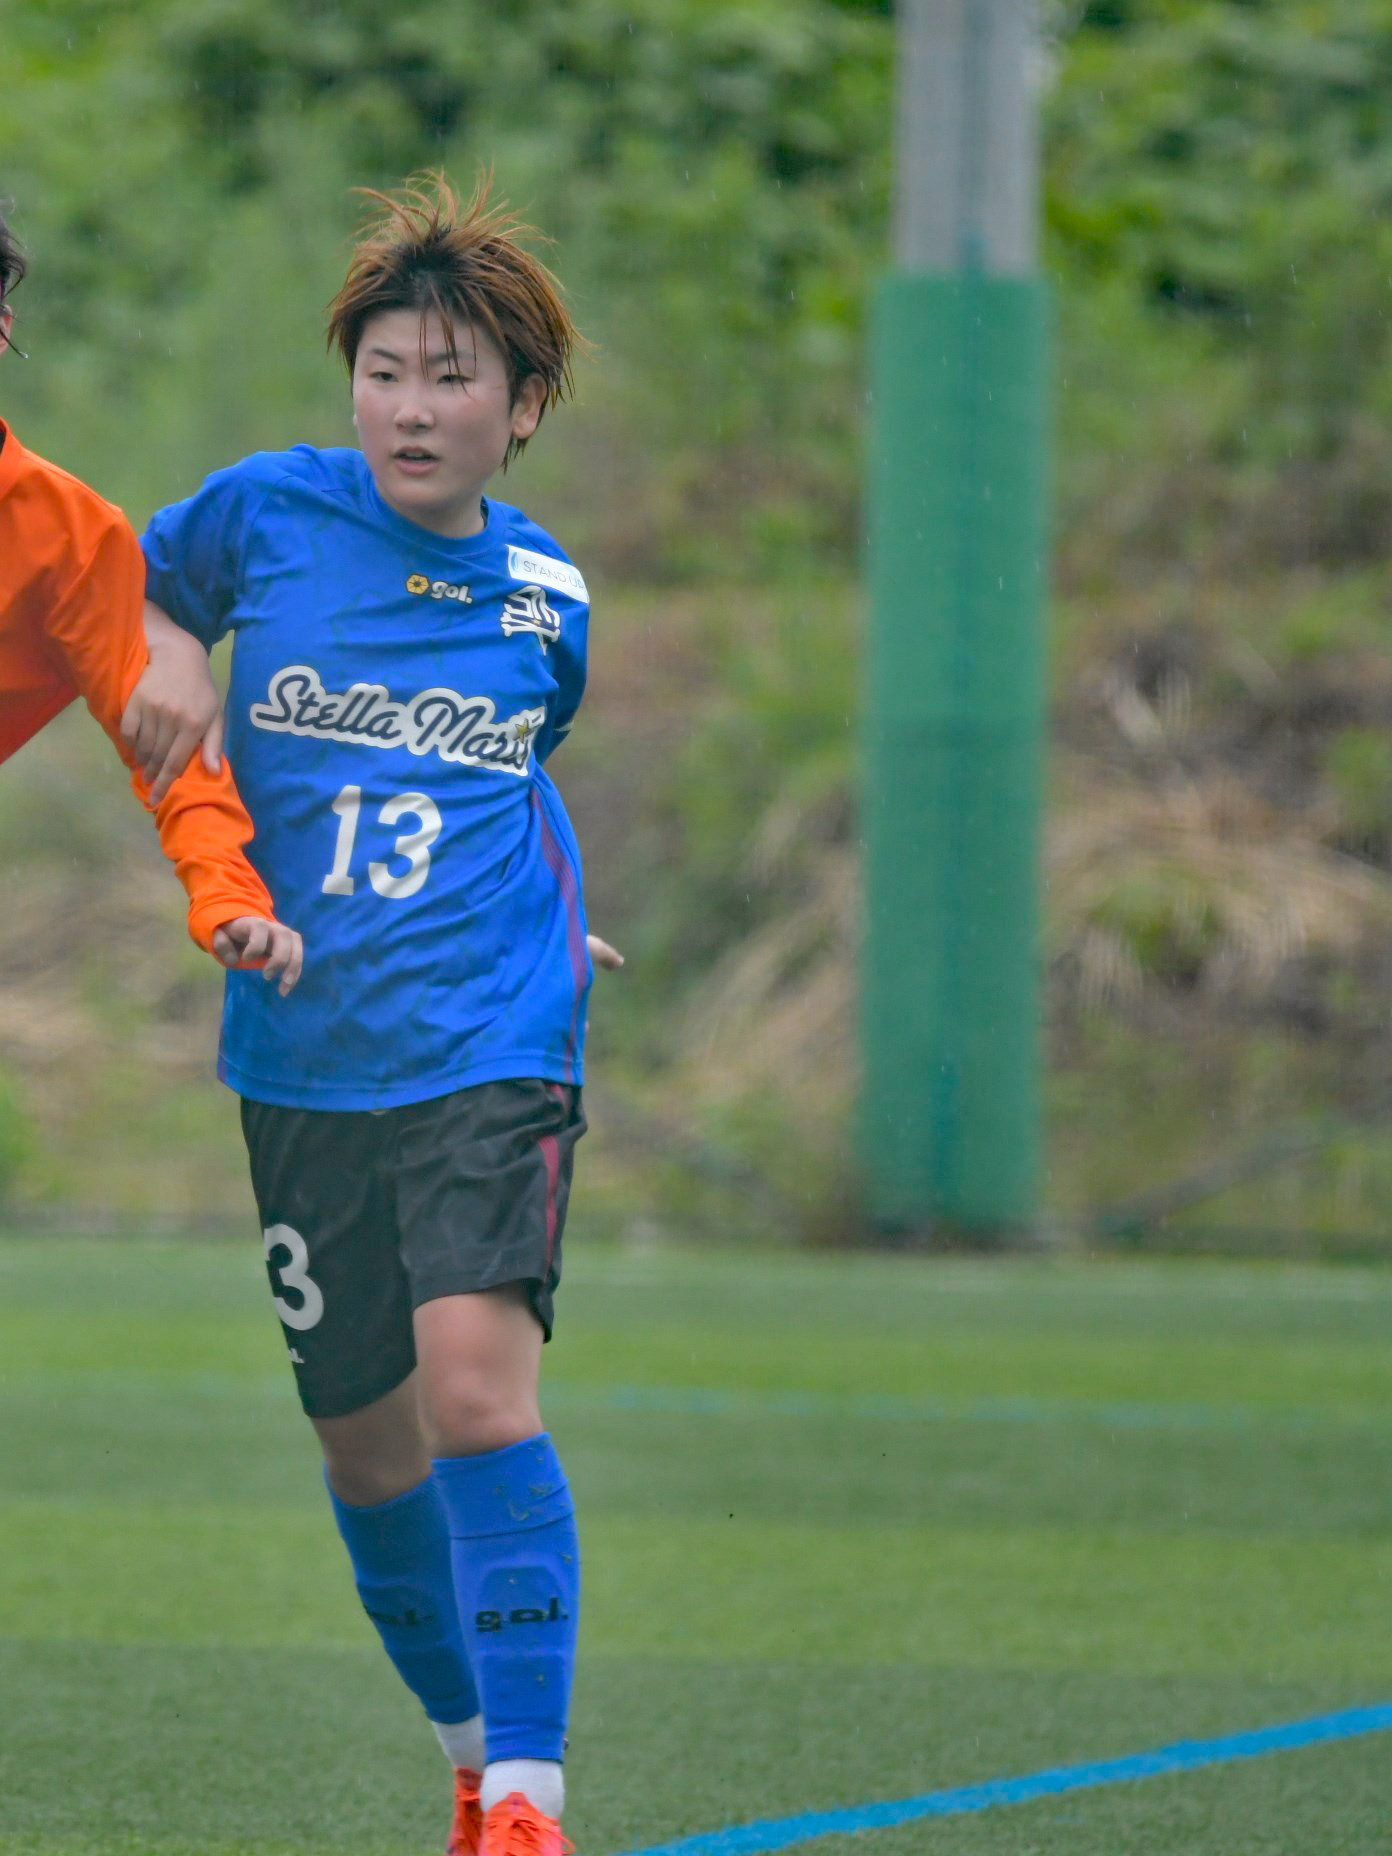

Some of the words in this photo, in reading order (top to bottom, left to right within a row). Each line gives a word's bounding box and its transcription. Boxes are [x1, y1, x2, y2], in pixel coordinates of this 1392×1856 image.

[523, 560, 566, 583] STAND
[256, 673, 402, 740] Stella
[321, 784, 443, 899] 13
